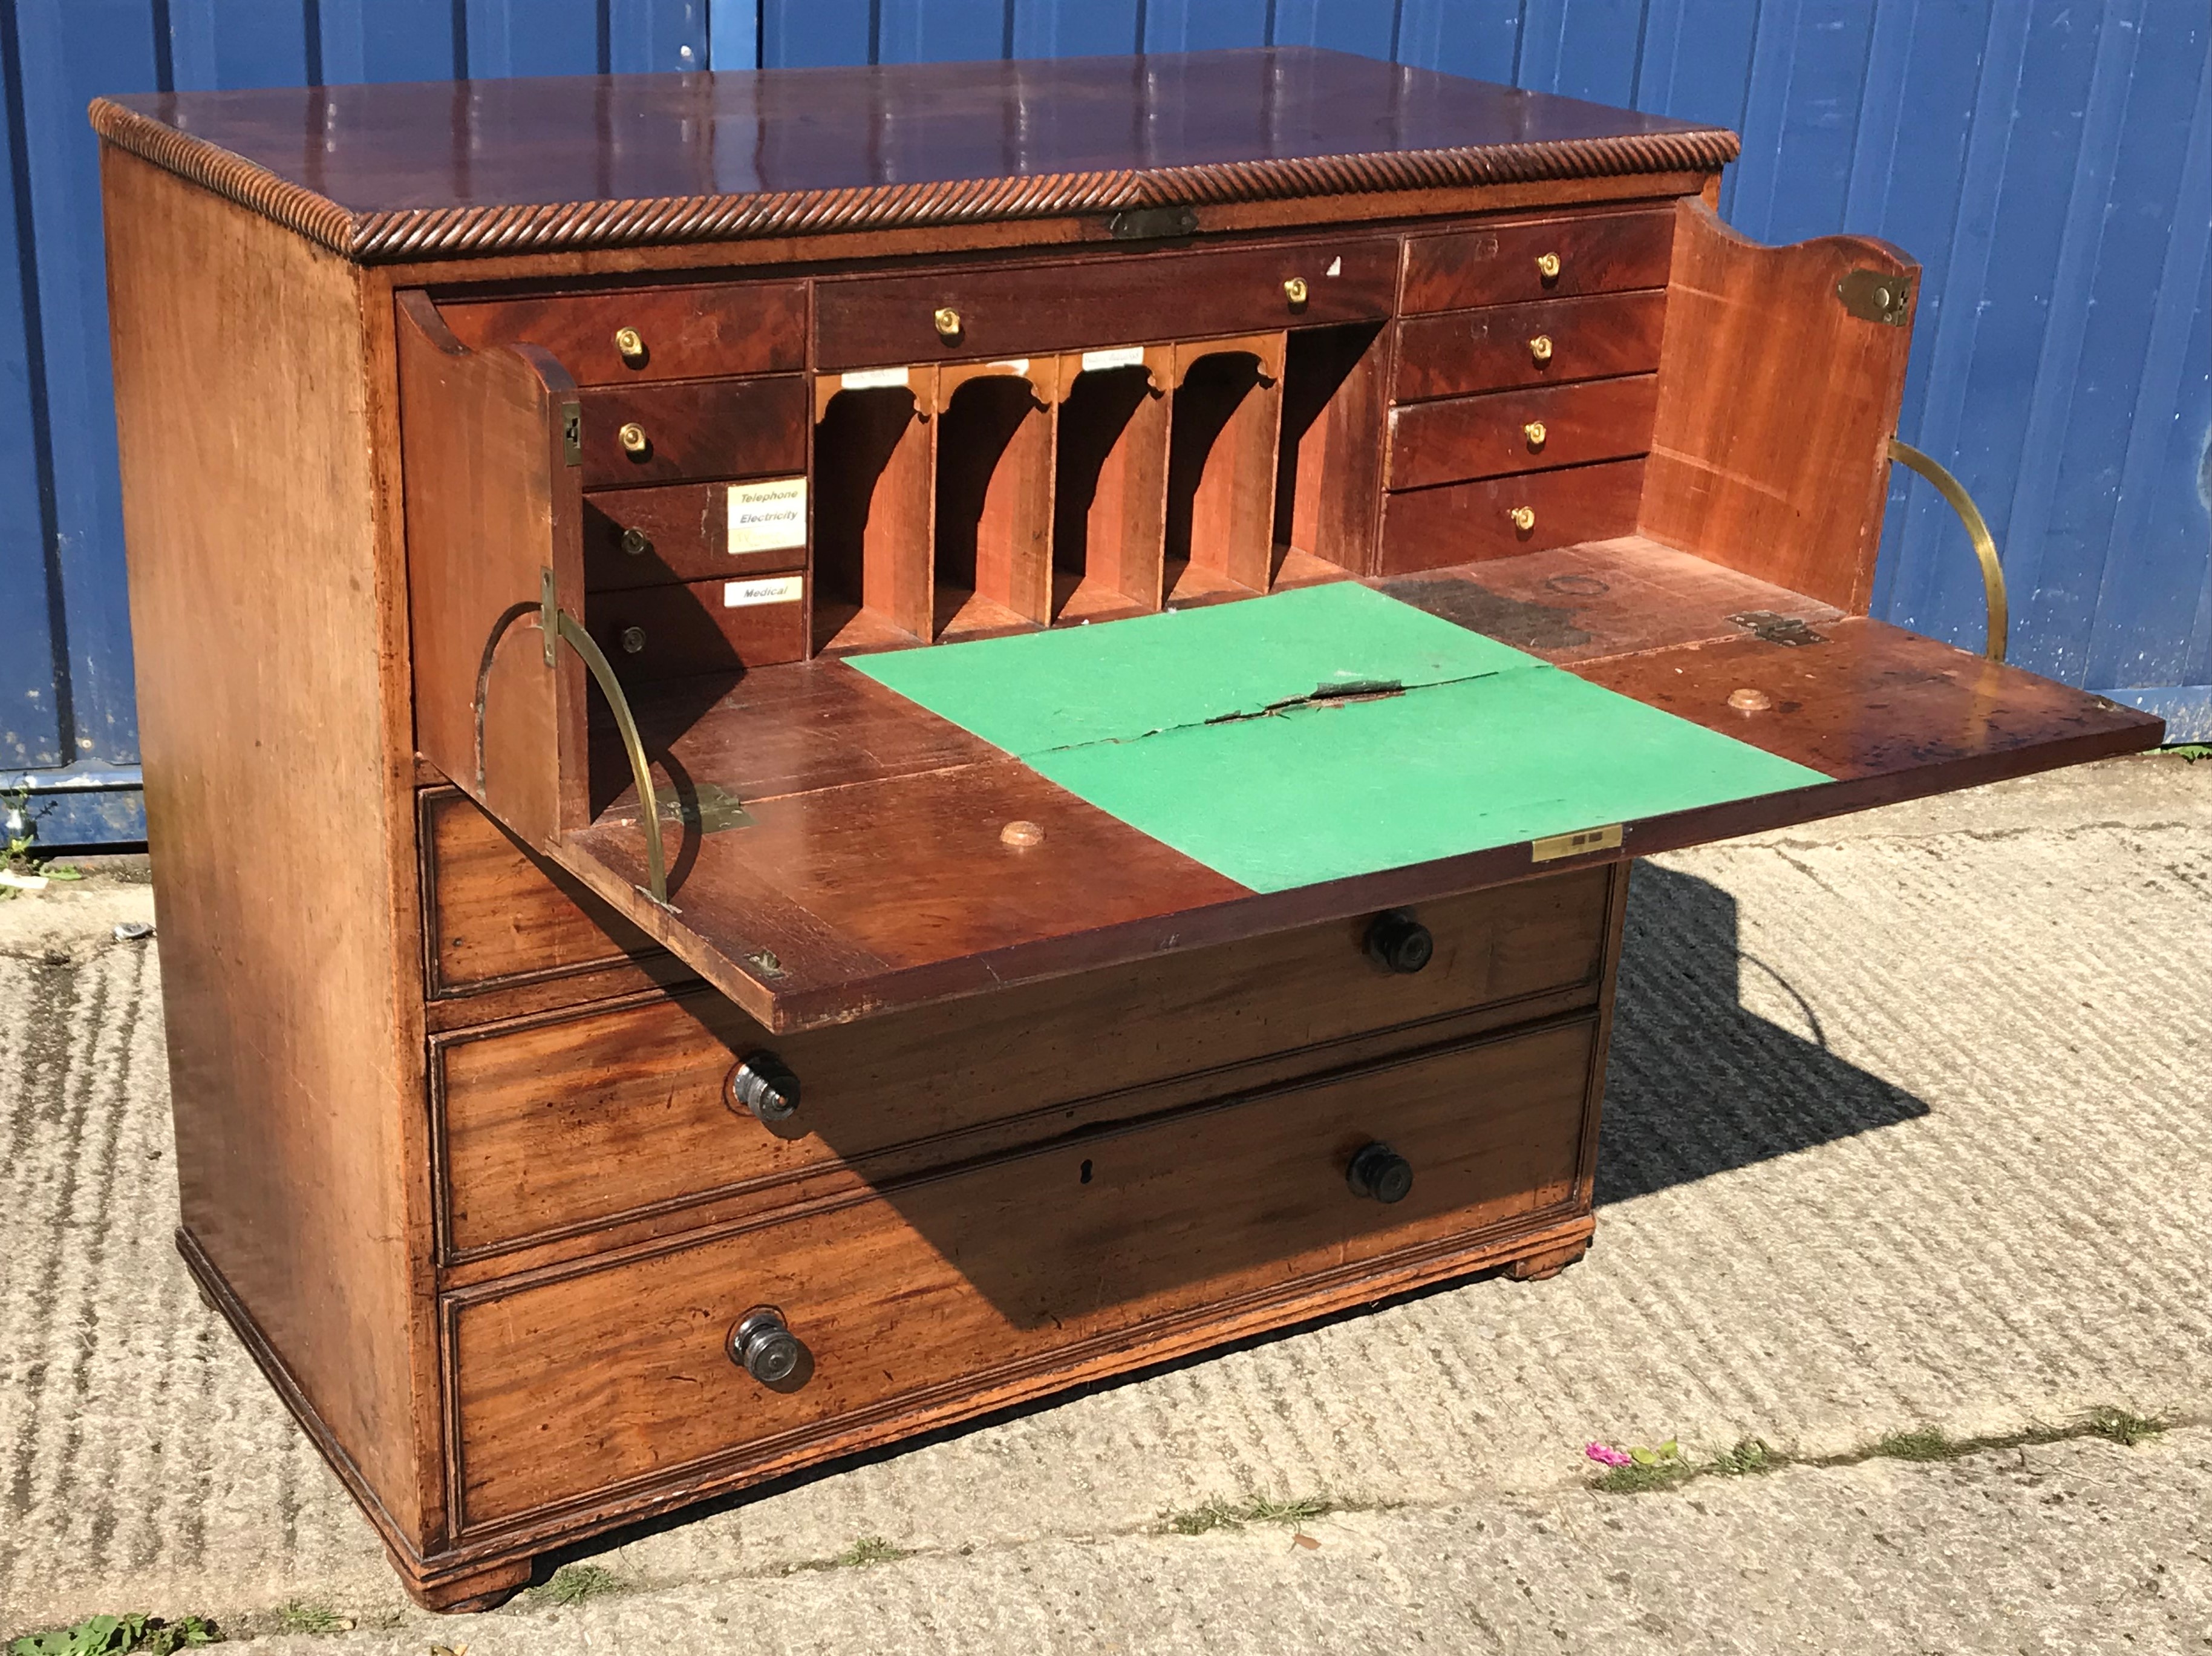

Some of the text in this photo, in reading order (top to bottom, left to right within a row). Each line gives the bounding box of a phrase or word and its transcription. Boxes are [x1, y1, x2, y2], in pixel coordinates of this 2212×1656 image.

[742, 490, 798, 503] Telephone
[740, 511, 798, 523] Electricity
[743, 586, 788, 598] Medical
